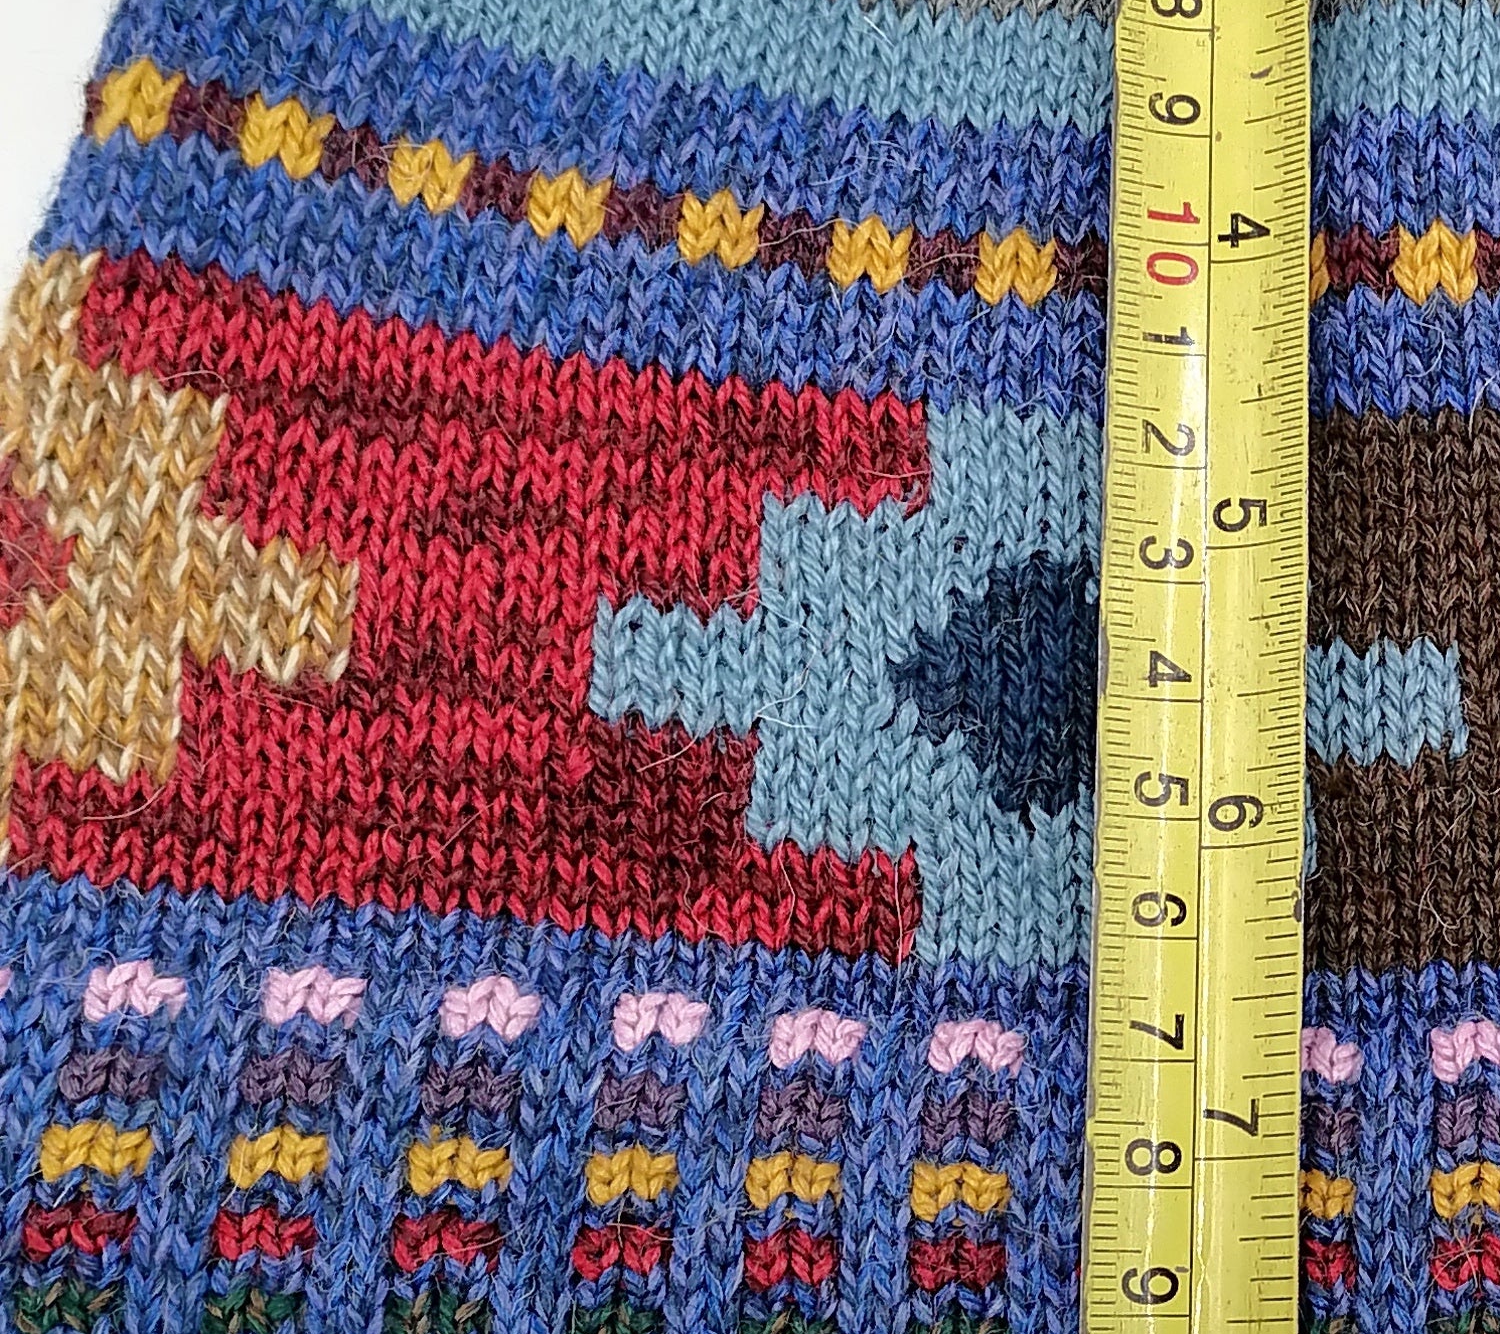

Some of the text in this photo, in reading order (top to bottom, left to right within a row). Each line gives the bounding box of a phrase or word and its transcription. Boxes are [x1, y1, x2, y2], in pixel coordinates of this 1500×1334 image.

[1148, 92, 1201, 125] 9
[1146, 202, 1200, 286] 10
[1217, 213, 1270, 248] 4
[1142, 326, 1195, 346] 1
[1142, 419, 1196, 456] 2
[1212, 497, 1267, 532] 5
[1139, 536, 1194, 569] 3
[1146, 650, 1192, 688] 4
[1134, 770, 1189, 807] 5
[1208, 795, 1264, 832] 6
[1132, 891, 1187, 927] 6
[1129, 1014, 1185, 1050] 7
[1203, 1098, 1259, 1136] 7
[1125, 1138, 1182, 1176] 8
[1121, 1267, 1179, 1305] 9
